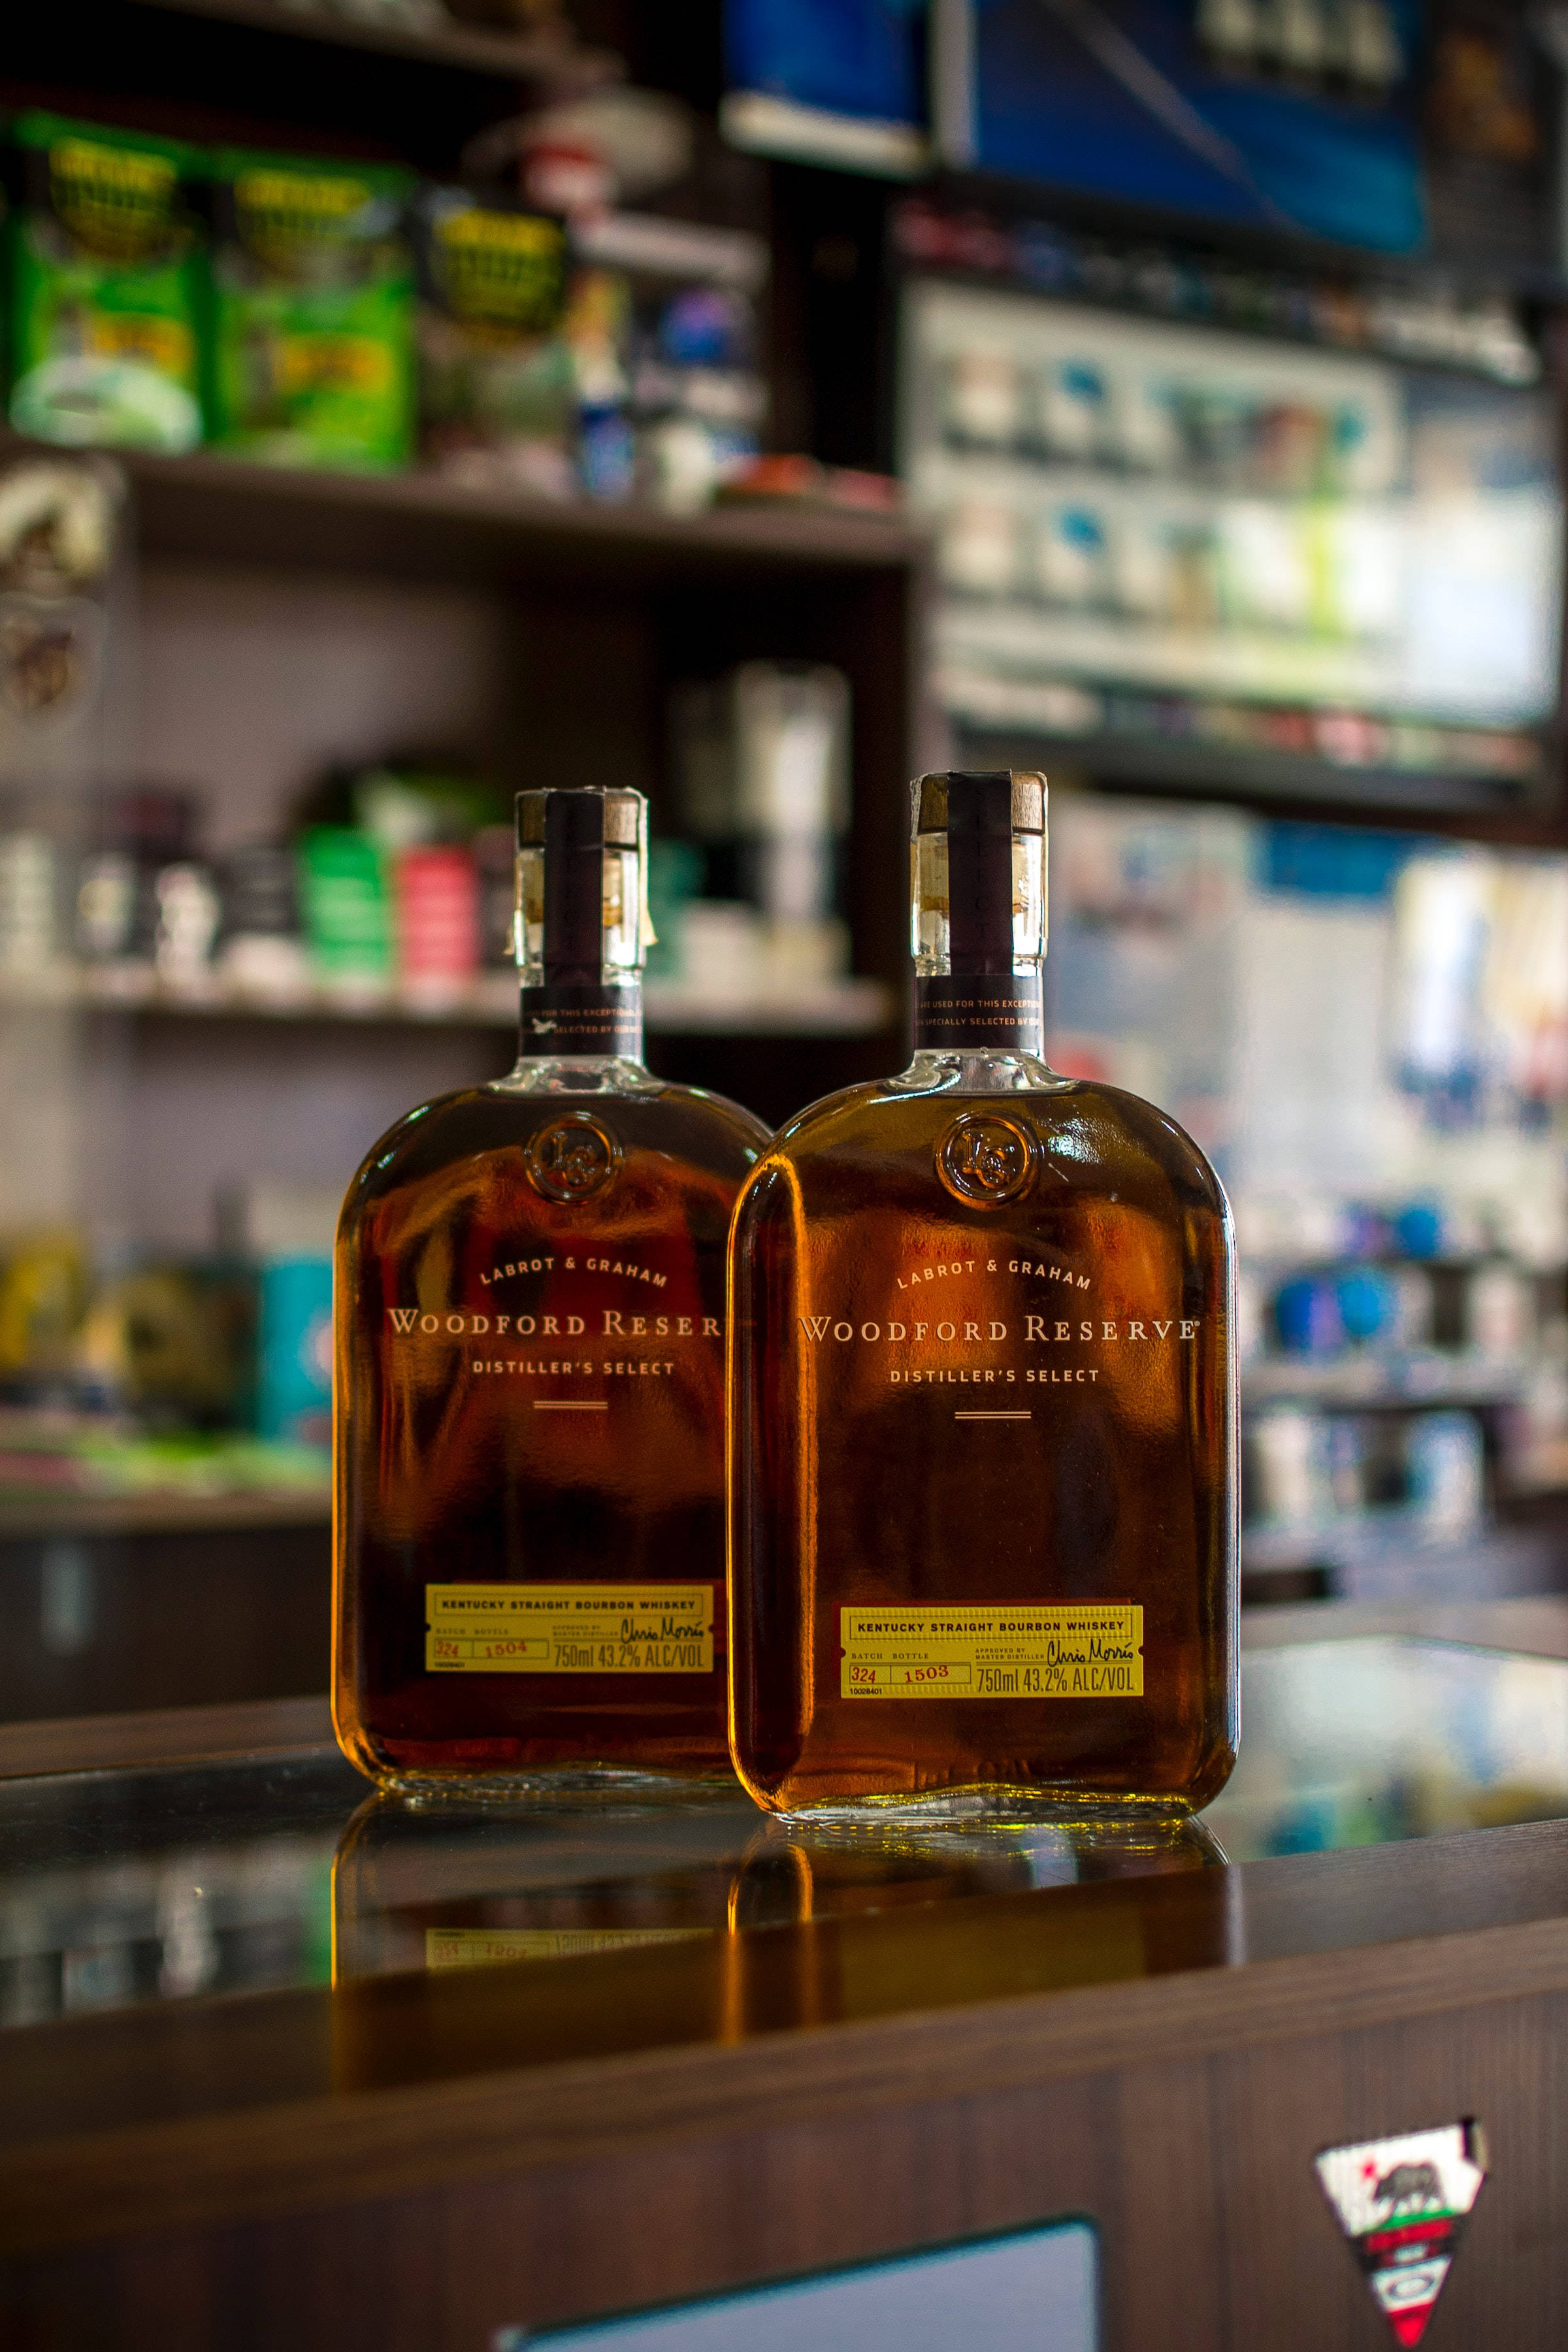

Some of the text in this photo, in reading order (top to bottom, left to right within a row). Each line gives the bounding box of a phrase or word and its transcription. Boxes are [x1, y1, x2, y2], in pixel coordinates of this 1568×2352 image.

[600, 1025, 611, 1034] BY
[480, 1257, 668, 1288] LABROT & GRAHAM
[898, 1259, 1090, 1290] LABROT & GRAHAM
[388, 1309, 721, 1335] WOODFORD RESER
[798, 1316, 1008, 1342] WOODFORD
[473, 1362, 674, 1375] DISTILLER'S SELECT
[890, 1369, 1099, 1382] DISTILLER'S SELECT
[442, 1601, 695, 1610] KENTUCKY STRAIGHT BOURBON WHISKEY
[858, 1622, 1124, 1633] KENTUCKY STRAIGHT BOURBON WHISKEY
[436, 1641, 459, 1658] 324
[485, 1640, 528, 1658] 1504
[555, 1644, 704, 1667] 750ml 43.2% ALC/VOL
[851, 1667, 876, 1684] 324
[905, 1665, 949, 1684] 1503
[978, 1667, 1134, 1692] 750ml 43.2% ALC/VOL
